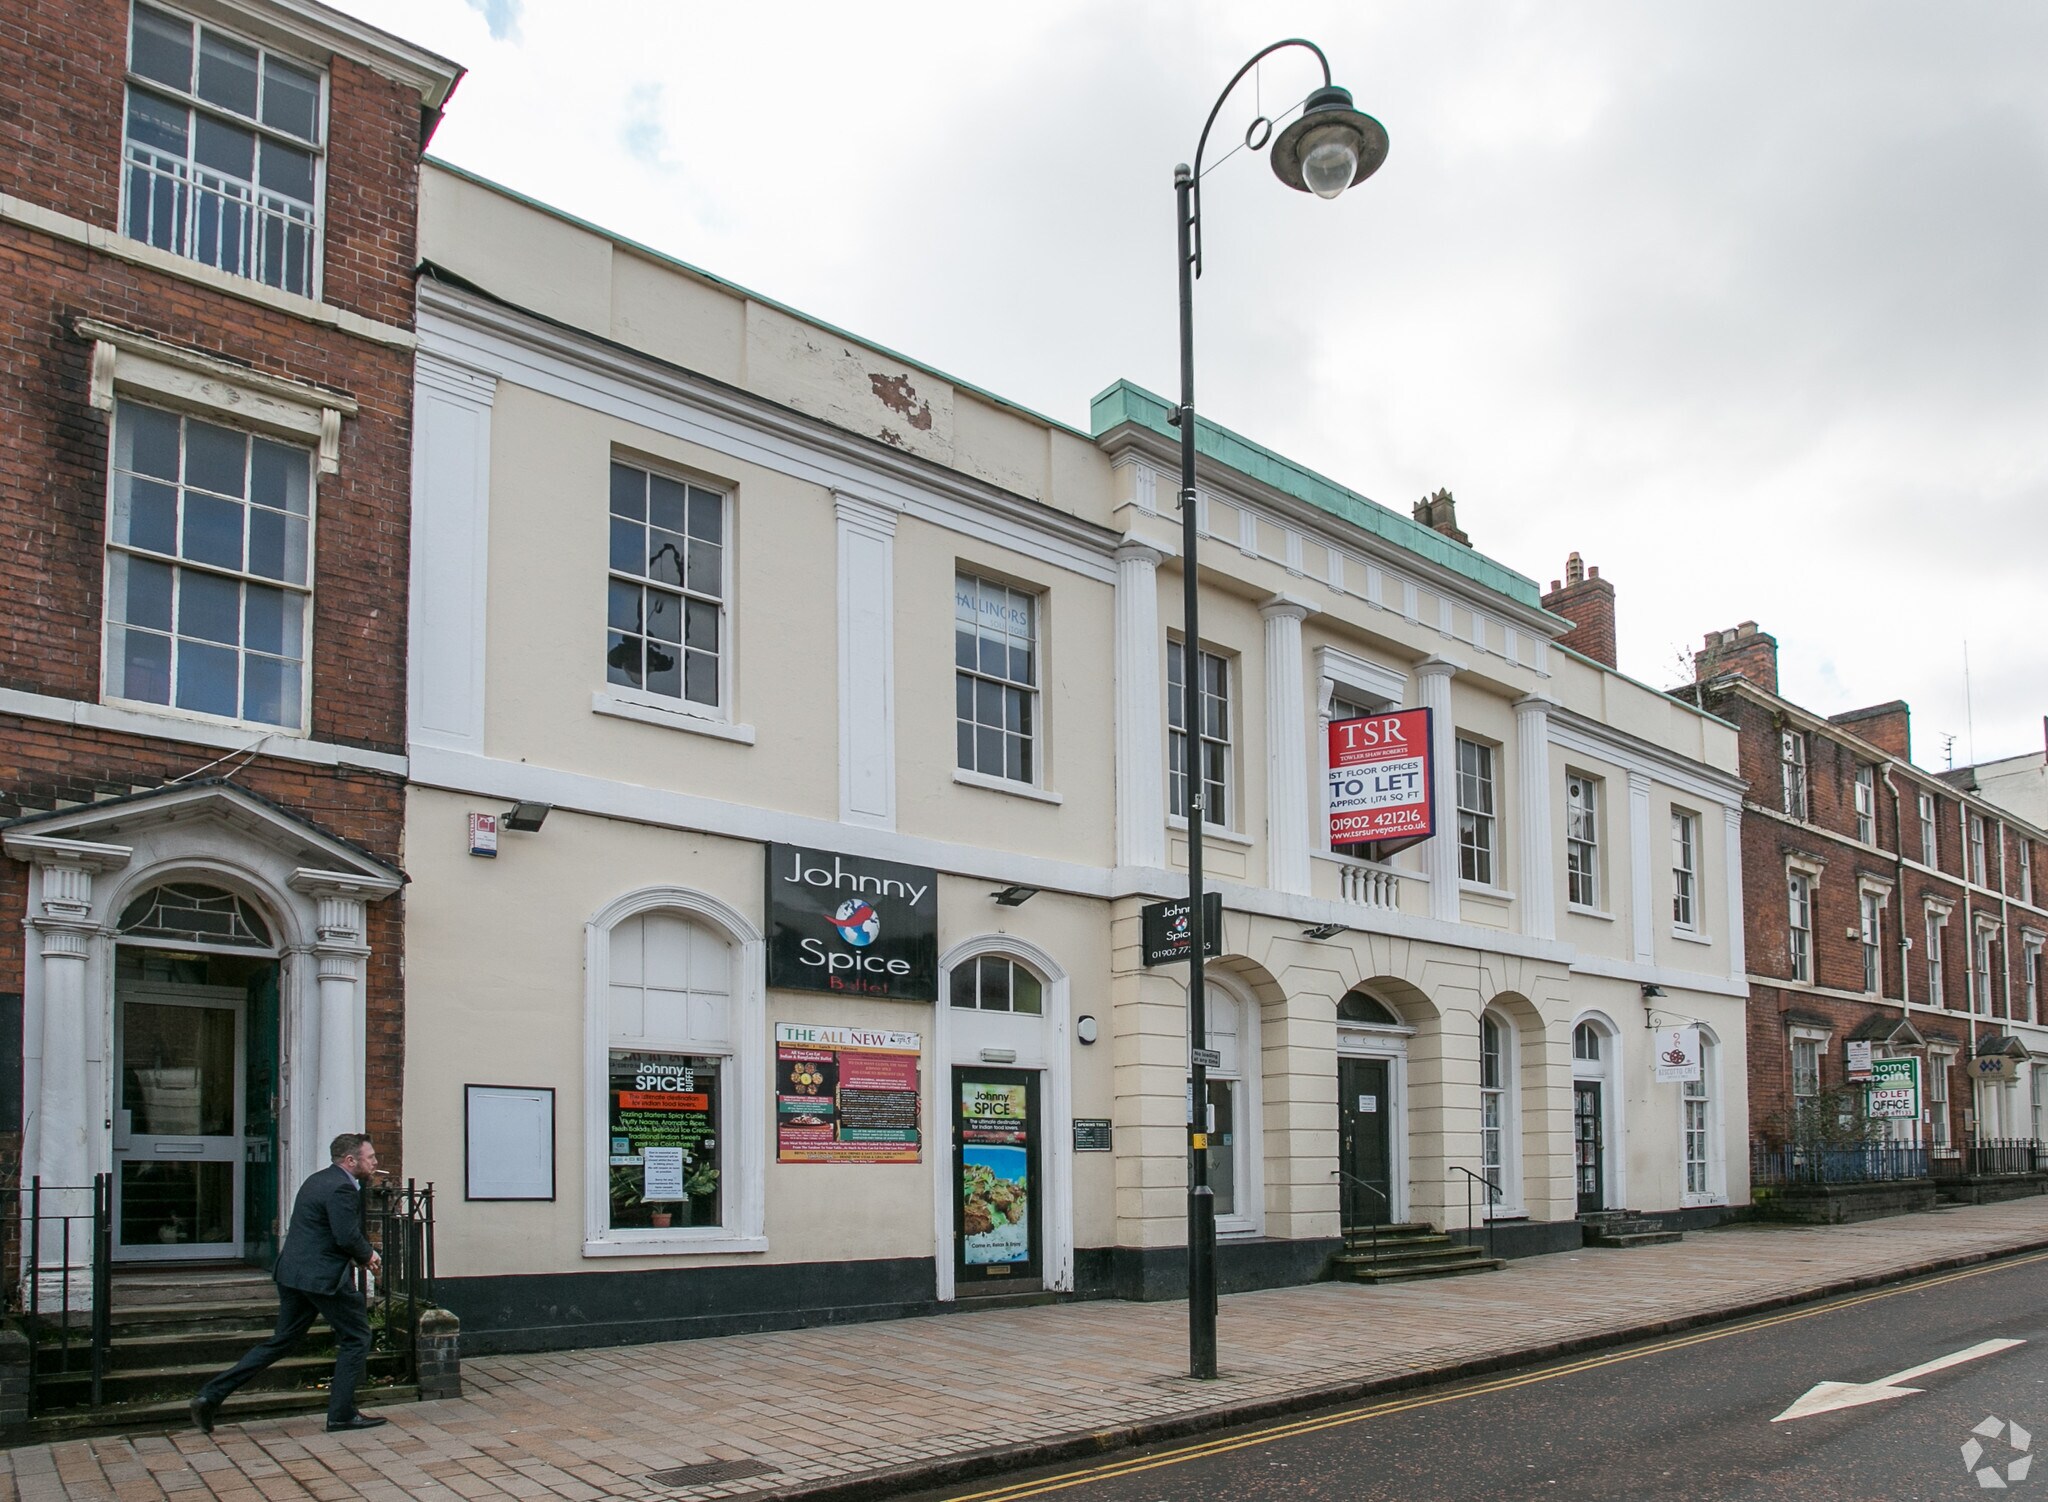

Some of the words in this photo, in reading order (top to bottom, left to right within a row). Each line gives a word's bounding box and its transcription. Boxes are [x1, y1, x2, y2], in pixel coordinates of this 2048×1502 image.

[1339, 718, 1407, 748] TSR
[1340, 753, 1365, 761] TOWLER
[1383, 747, 1408, 756] ROBERTS
[1346, 767, 1377, 777] FLOOR
[1381, 762, 1418, 773] OFFICES
[1330, 780, 1364, 798] TO
[1375, 772, 1418, 792] LET
[1330, 796, 1366, 809] APPROX
[1370, 795, 1387, 804] 1,174
[1390, 792, 1404, 801] SQ
[1407, 790, 1420, 799] FT
[1330, 815, 1369, 831] 01902
[1374, 809, 1420, 826] 421216
[784, 852, 928, 906] Johnny
[799, 938, 911, 975] Spice
[1152, 948, 1176, 959] 01902
[784, 1028, 816, 1042] THE
[820, 1031, 846, 1044] ALL
[851, 1032, 886, 1046] NEW
[1202, 1052, 1218, 1060] loading
[636, 1062, 684, 1076] Johnny
[1872, 1063, 1910, 1072] home
[636, 1076, 685, 1092] SPICE
[685, 1068, 694, 1092] BUFFET
[1872, 1071, 1910, 1082] point
[974, 1091, 1009, 1102] Johnny
[974, 1102, 1010, 1115] SPICE
[1873, 1099, 1910, 1110] OFFICE
